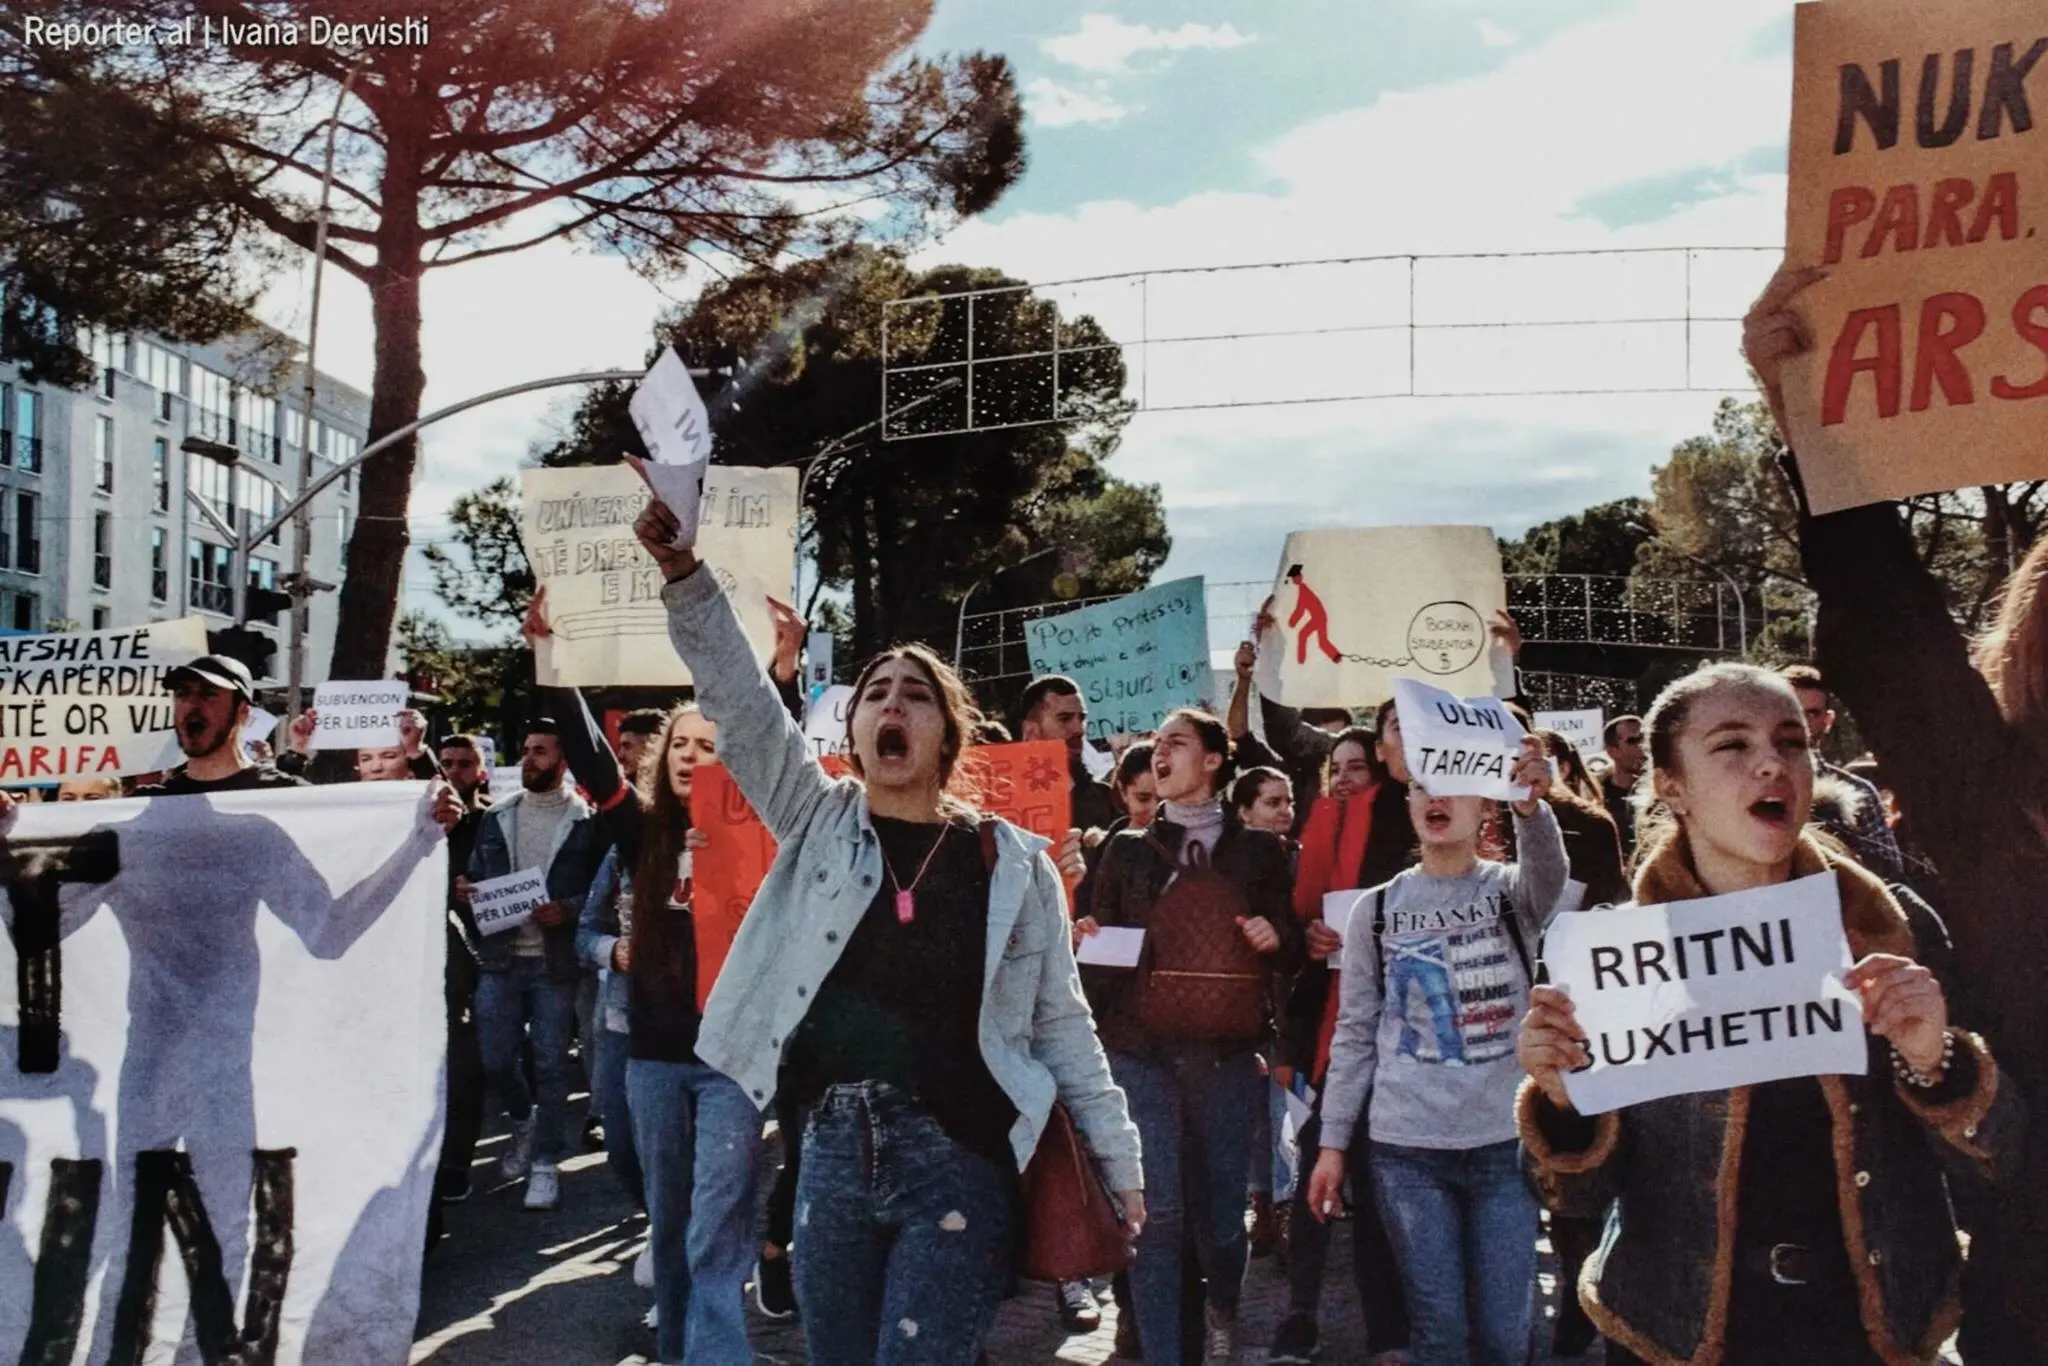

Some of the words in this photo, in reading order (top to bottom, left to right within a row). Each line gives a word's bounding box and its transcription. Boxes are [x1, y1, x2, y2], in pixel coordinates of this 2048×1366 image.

[1833, 38, 2048, 155] NUK
[65, 703, 109, 736] OR
[1436, 700, 1504, 731] ULNI
[1421, 747, 1520, 783] TARIFA
[1591, 918, 1796, 991] RRITNI
